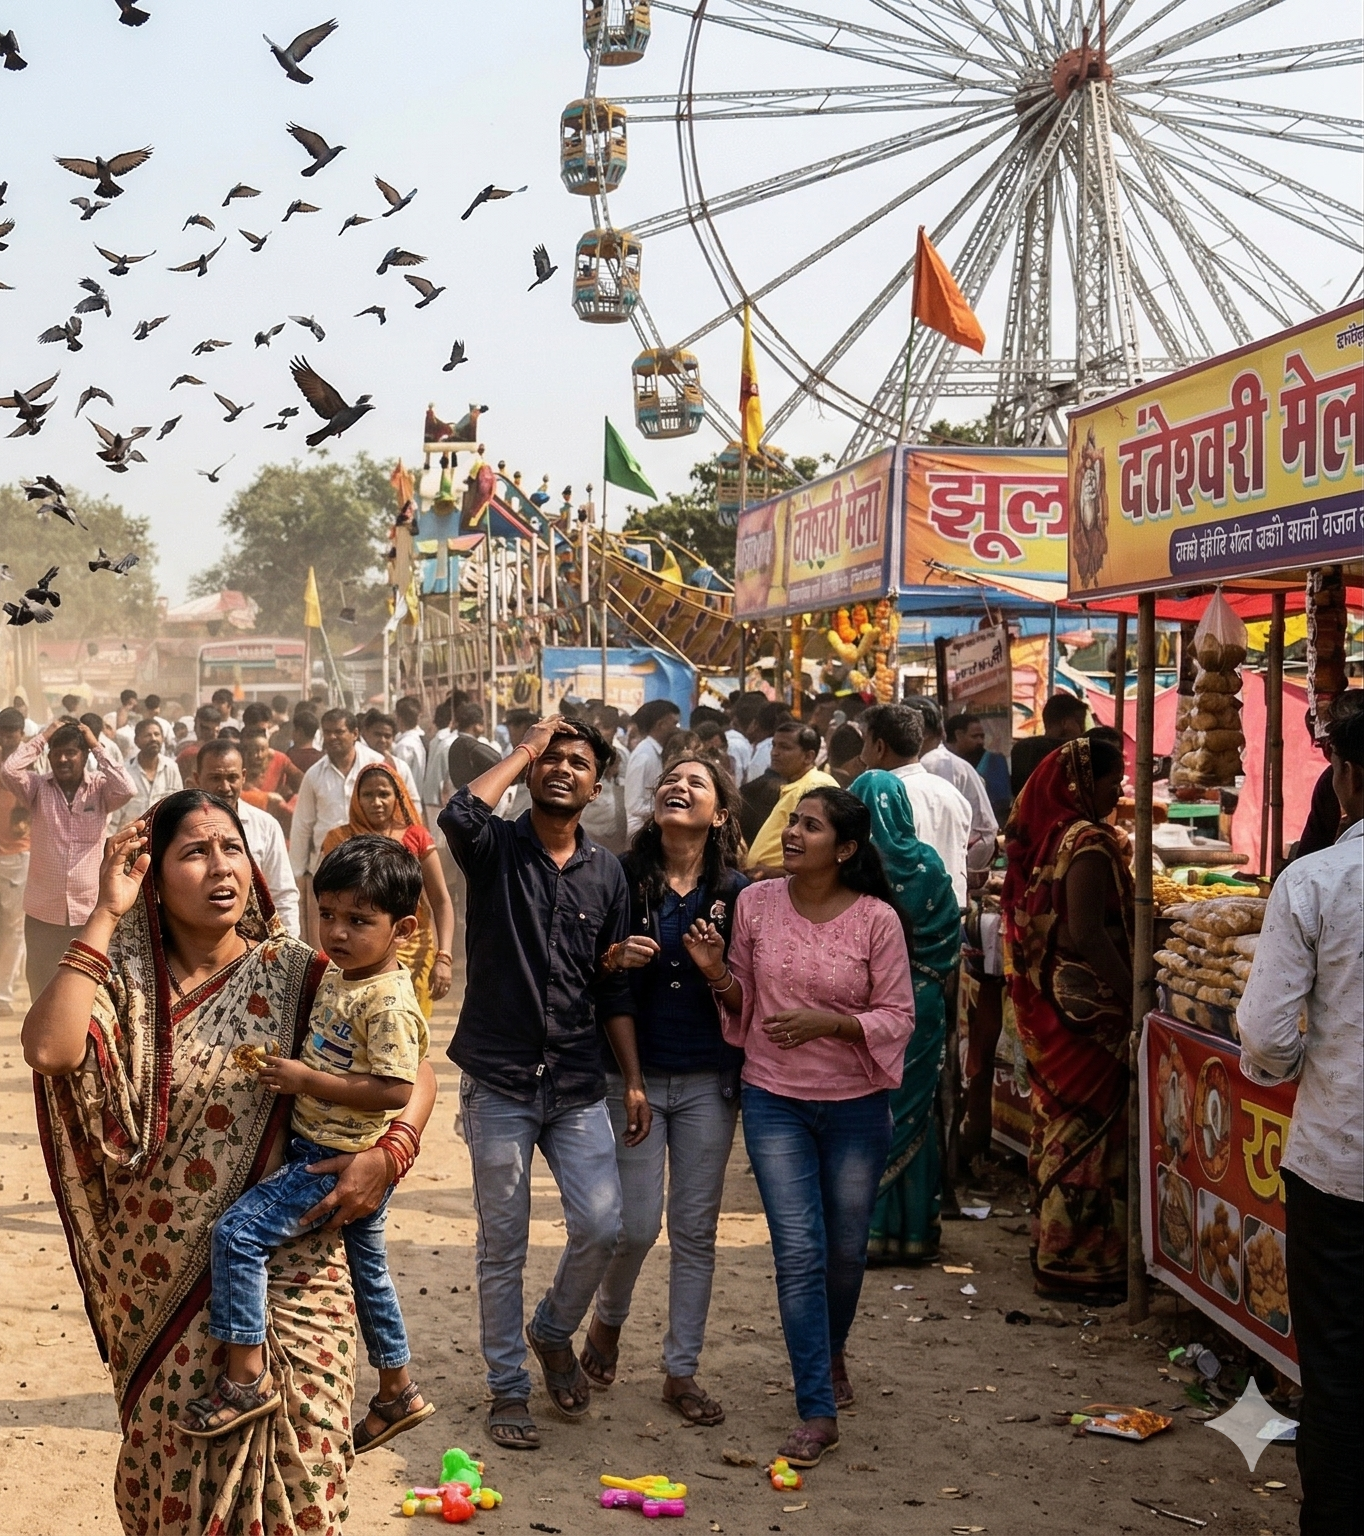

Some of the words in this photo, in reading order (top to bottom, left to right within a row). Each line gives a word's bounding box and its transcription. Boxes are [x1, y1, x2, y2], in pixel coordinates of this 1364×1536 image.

[1280, 353, 1364, 479] मेल
[845, 473, 881, 549] मेला
[929, 474, 1068, 560] झूल
